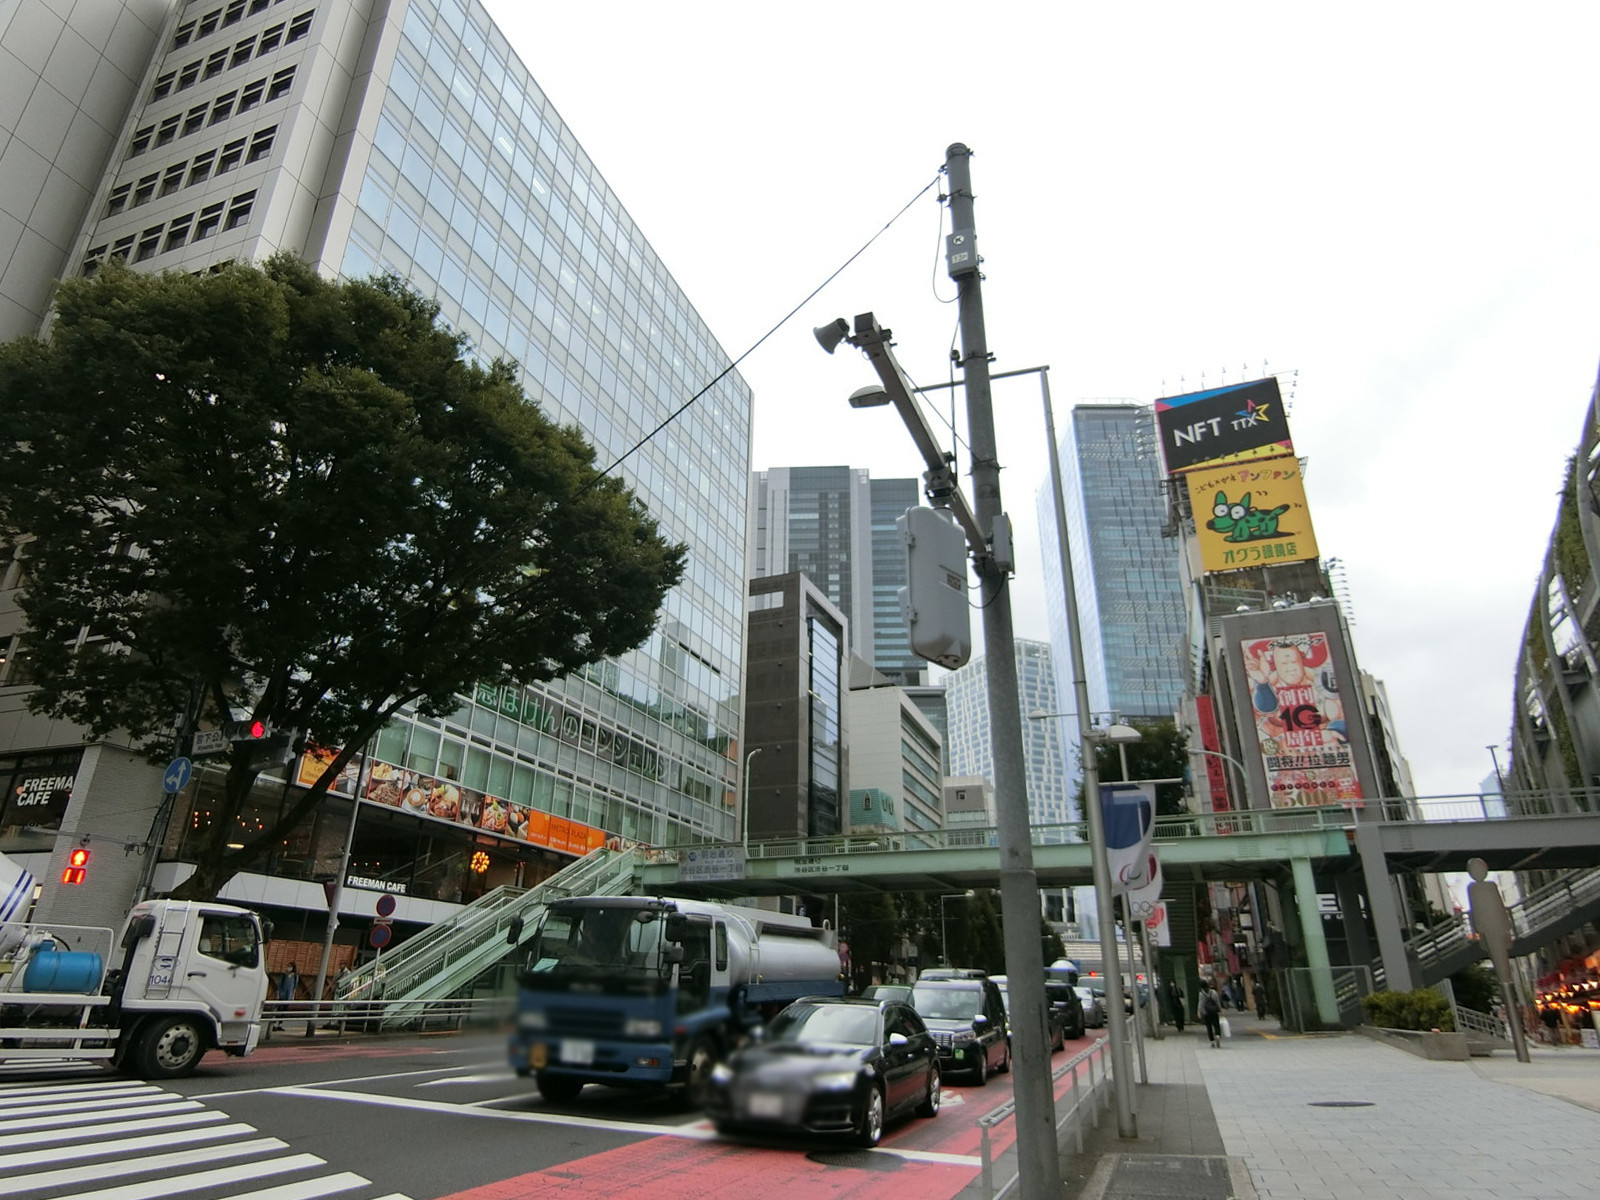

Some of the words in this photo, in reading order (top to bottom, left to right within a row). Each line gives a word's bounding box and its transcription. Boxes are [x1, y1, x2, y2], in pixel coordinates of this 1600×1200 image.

[1174, 417, 1221, 446] NFT
[1231, 412, 1257, 432] TTX
[1223, 542, 1298, 564] オグラ眼鏡店
[22, 775, 74, 792] FREEMA
[17, 791, 52, 806] CAFE
[347, 875, 385, 892] FREEMAN
[386, 880, 407, 893] CAFE
